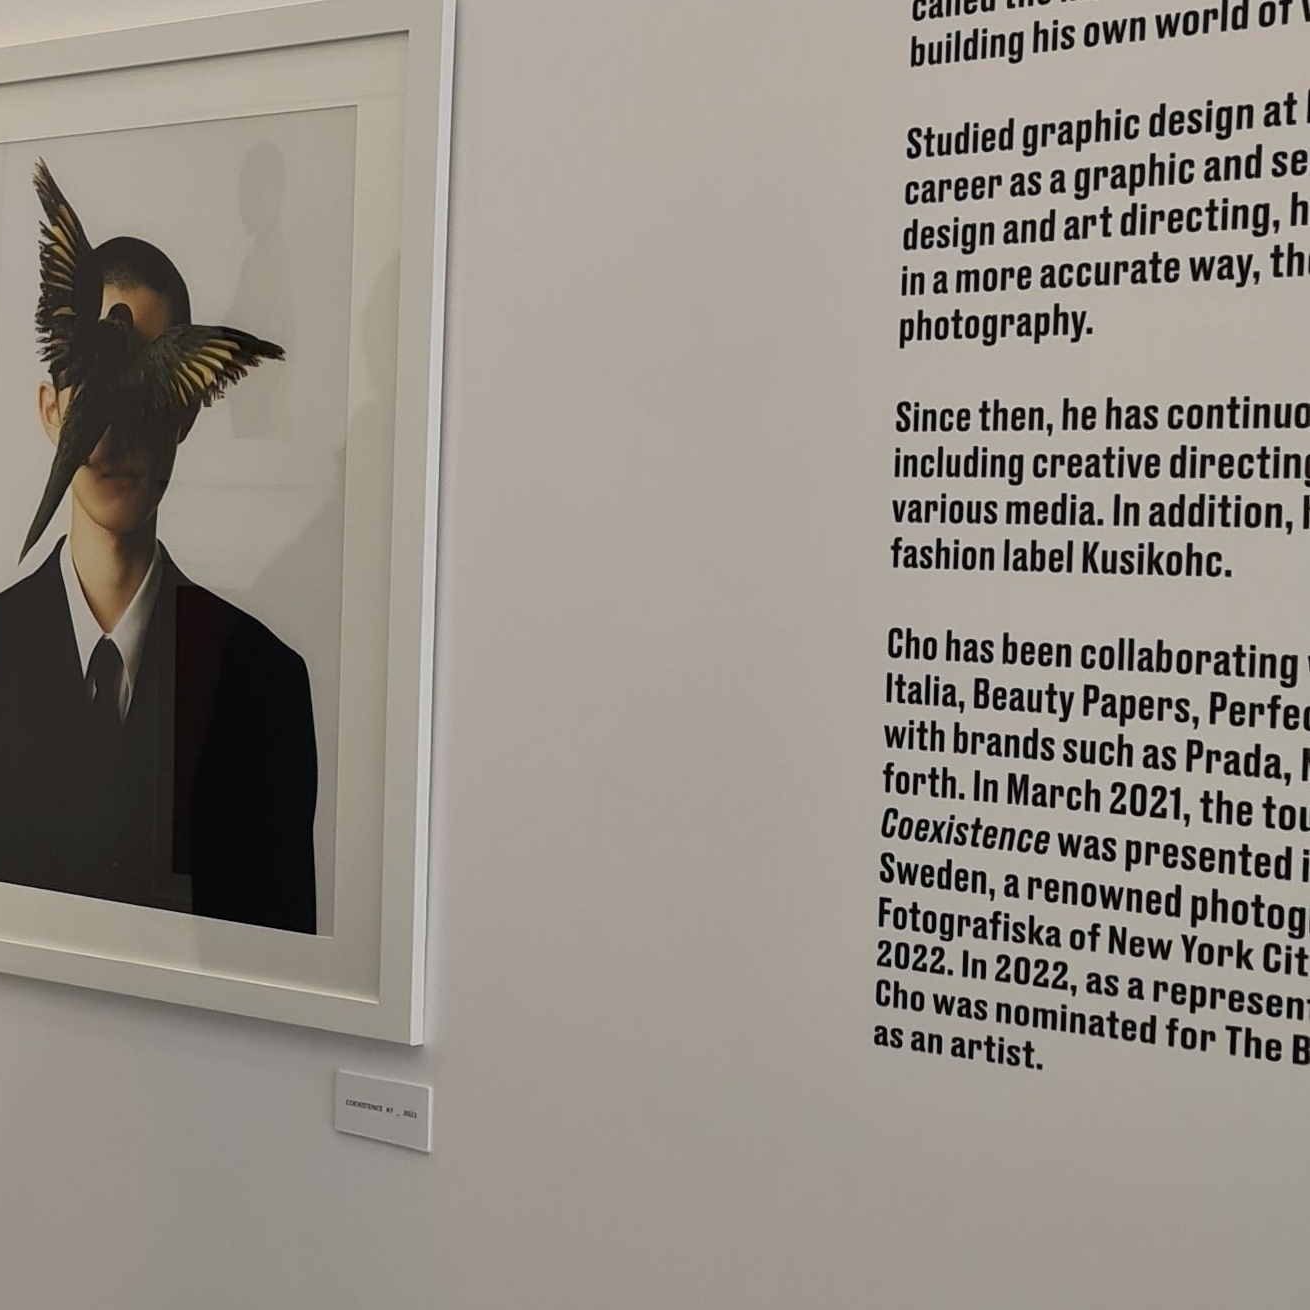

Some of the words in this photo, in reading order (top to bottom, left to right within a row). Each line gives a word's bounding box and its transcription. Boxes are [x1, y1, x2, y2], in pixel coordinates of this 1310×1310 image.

[910, 27, 1025, 68] building
[1032, 19, 1076, 54] his
[1083, 16, 1146, 48] own
[1155, 0, 1249, 39] world
[1258, 0, 1293, 28] of
[906, 117, 1015, 160] Studied
[1022, 108, 1140, 157] graphic
[1148, 99, 1254, 141] design
[1263, 91, 1298, 128] at
[904, 174, 1003, 206] career
[1009, 171, 1042, 198] as
[1049, 169, 1067, 195] a
[1073, 152, 1195, 201] graphic
[1203, 143, 1263, 183] and
[903, 216, 995, 255] design
[1002, 208, 1056, 245] and
[1063, 205, 1113, 241] art
[1120, 197, 1280, 238] directing,
[901, 265, 925, 297] in
[932, 270, 949, 295] a
[955, 265, 1032, 294] more
[1039, 251, 1181, 289] accurate
[1188, 253, 1261, 288] way,
[1269, 242, 1310, 278] th
[899, 302, 1093, 349] photography.
[895, 400, 971, 433] Since
[978, 398, 1054, 437] then,
[1061, 397, 1097, 431] he
[1105, 396, 1159, 430] has
[894, 445, 1024, 486] including
[1032, 446, 1161, 479] creative
[892, 492, 998, 525] various
[1005, 492, 1104, 526] media.
[1112, 493, 1140, 527] In
[1148, 493, 1293, 535] addition,
[890, 536, 995, 571] fashion
[1003, 538, 1074, 574] label
[1081, 540, 1232, 578] Kusikohc.
[887, 627, 938, 661] Cho
[945, 629, 995, 664] has
[1002, 632, 1072, 668] been
[1080, 637, 1299, 689] collaborating
[885, 672, 965, 714] Italia,
[973, 677, 1075, 723] Beauty
[1082, 683, 1200, 730] Papers,
[883, 719, 945, 753] with
[953, 721, 1056, 762] brands
[1062, 733, 1134, 768] such
[1142, 744, 1177, 772] as
[1185, 738, 1292, 787] Prada,
[882, 761, 965, 801] forth.
[973, 769, 999, 804] In
[1006, 772, 1101, 813] March
[1109, 781, 1191, 828] 2021,
[1199, 789, 1253, 827] the
[880, 807, 1051, 855] Coexistence
[1057, 832, 1117, 863] was
[1124, 839, 1293, 881] presented
[879, 851, 996, 902] Sweden,
[1003, 873, 1020, 899] a
[1027, 876, 1182, 919] renowned
[1190, 887, 1310, 940] photog
[878, 896, 1062, 949] Fotografiska
[1069, 922, 1102, 953] of
[1108, 925, 1173, 961] New
[1180, 933, 1254, 971] York
[876, 939, 954, 977] 2022.
[961, 949, 987, 981] In
[994, 953, 1078, 997] 2022,
[1085, 972, 1120, 997] as
[1127, 977, 1145, 1001] a
[1152, 979, 1310, 1021] represen
[873, 1025, 904, 1049] as
[910, 1030, 943, 1056] an
[950, 1034, 1043, 1071] artist.
[875, 978, 925, 1012] Cho
[932, 993, 988, 1021] was
[995, 1001, 1157, 1045] nominated
[1165, 1017, 1216, 1052] for
[1224, 1024, 1283, 1062] The
